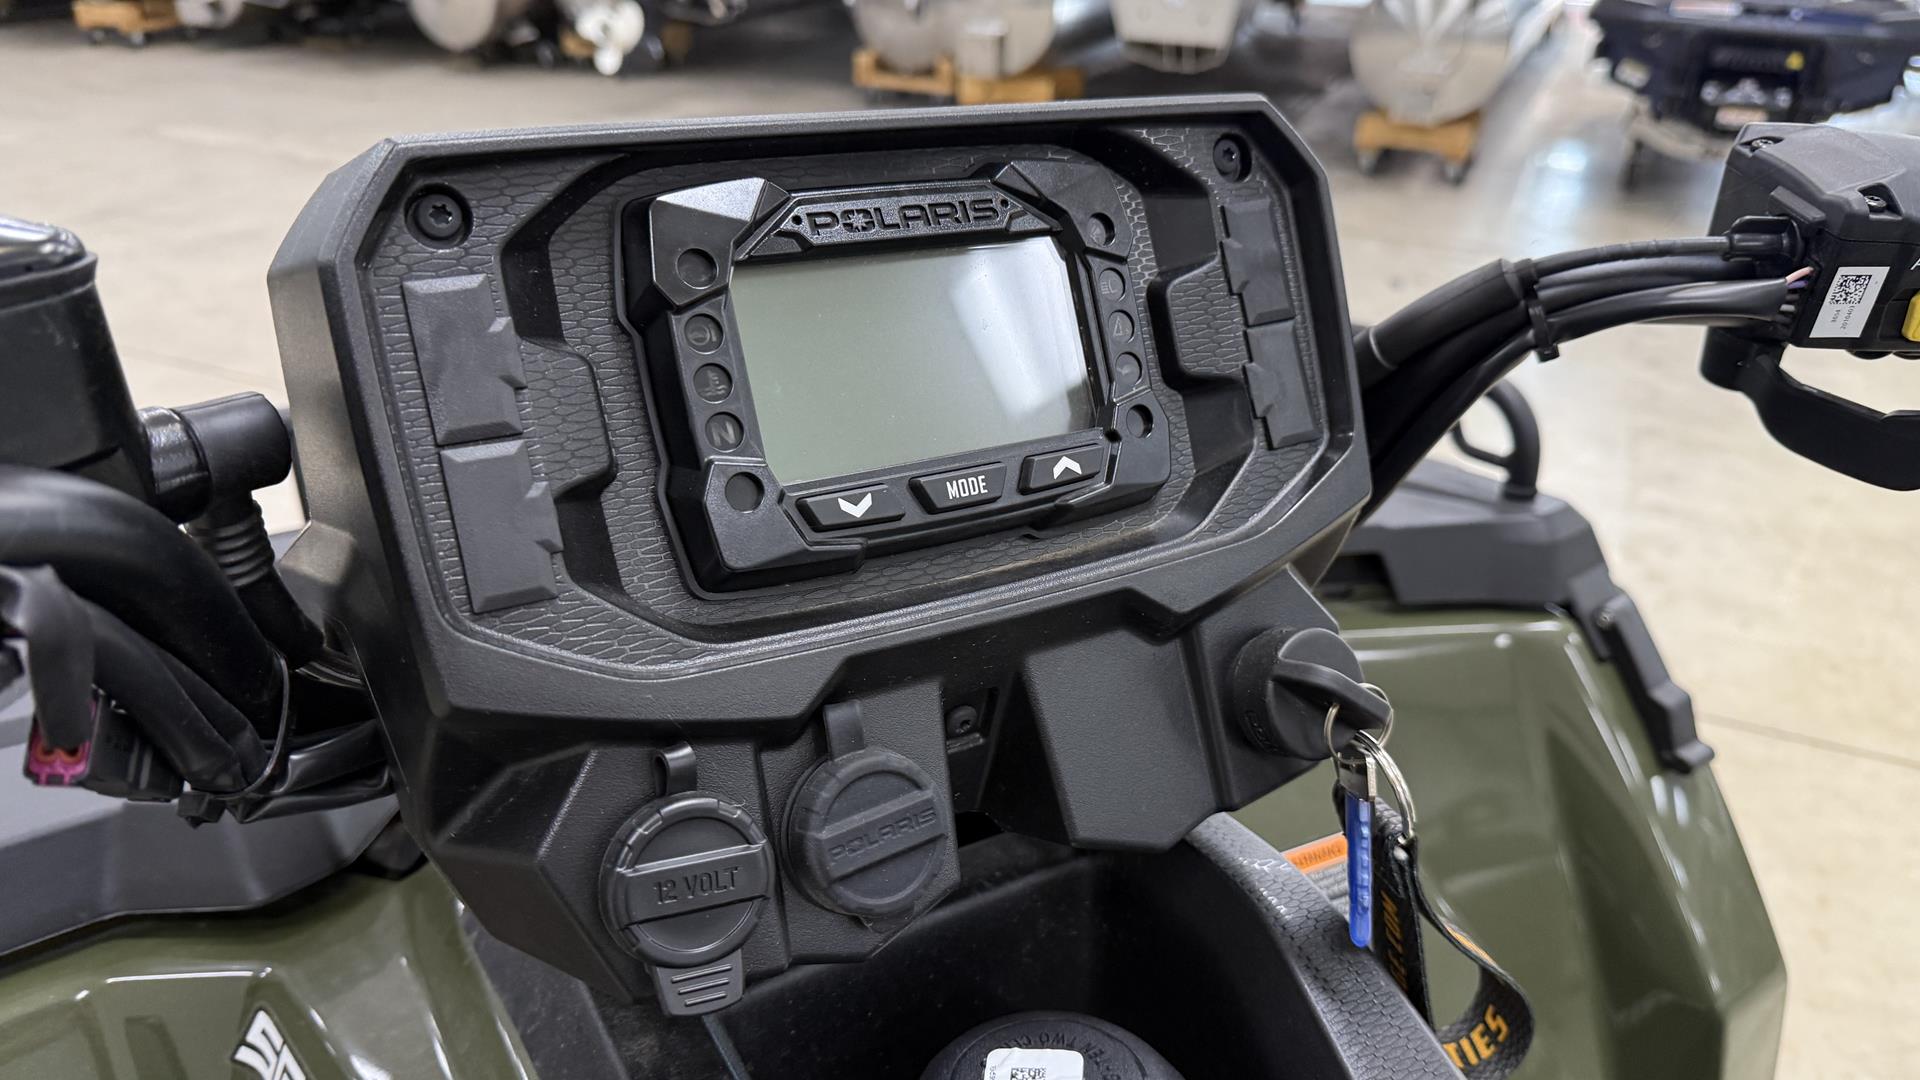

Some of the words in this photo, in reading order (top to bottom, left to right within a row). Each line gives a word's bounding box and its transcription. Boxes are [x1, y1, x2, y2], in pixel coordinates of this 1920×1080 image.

[805, 198, 1000, 236] POLARIS
[711, 421, 736, 447] N
[946, 475, 988, 500] MODE
[828, 806, 937, 865] POLARIS
[653, 879, 678, 905] 12
[681, 867, 740, 899] VOLT
